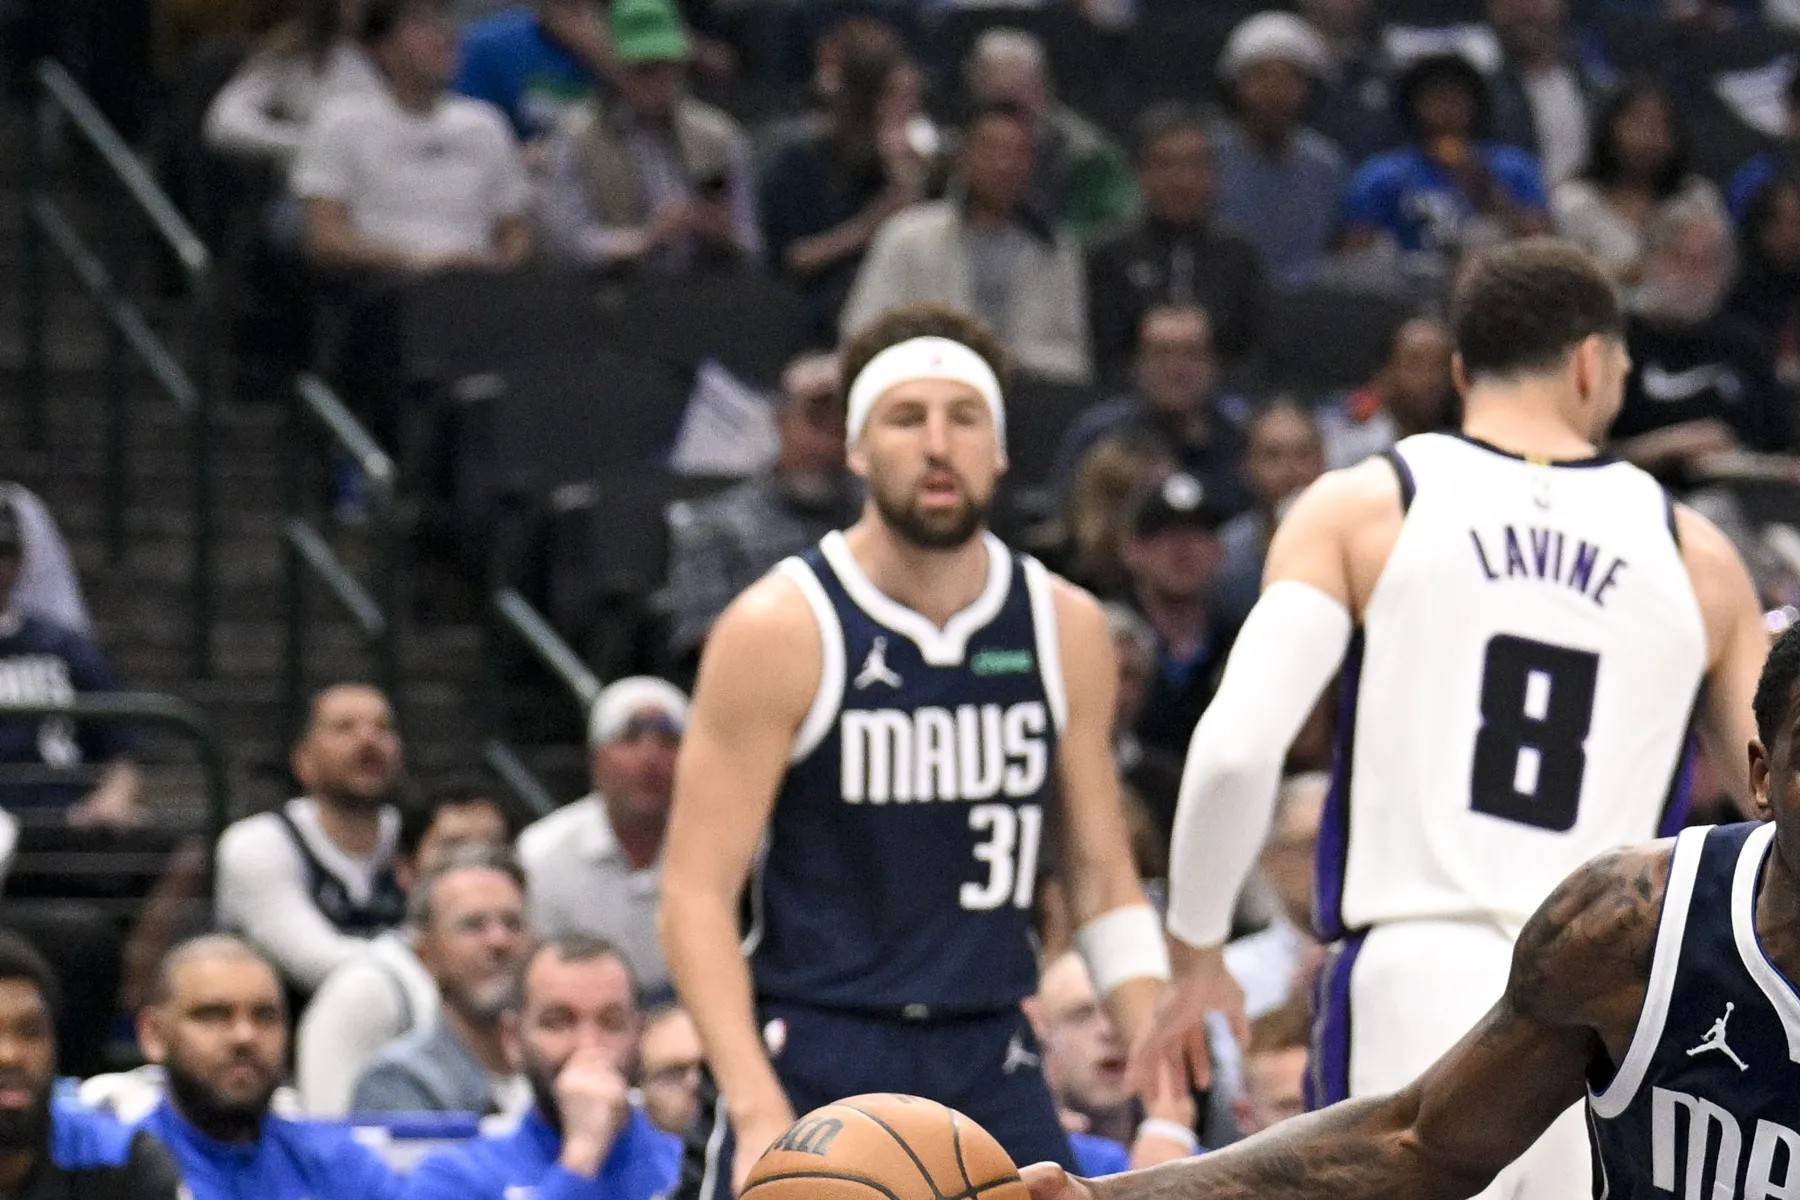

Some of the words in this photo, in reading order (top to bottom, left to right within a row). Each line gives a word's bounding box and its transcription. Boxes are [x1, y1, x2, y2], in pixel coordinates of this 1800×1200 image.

[1469, 524, 1629, 607] LAVINE
[1468, 633, 1601, 832] 8
[960, 804, 1043, 911] 31
